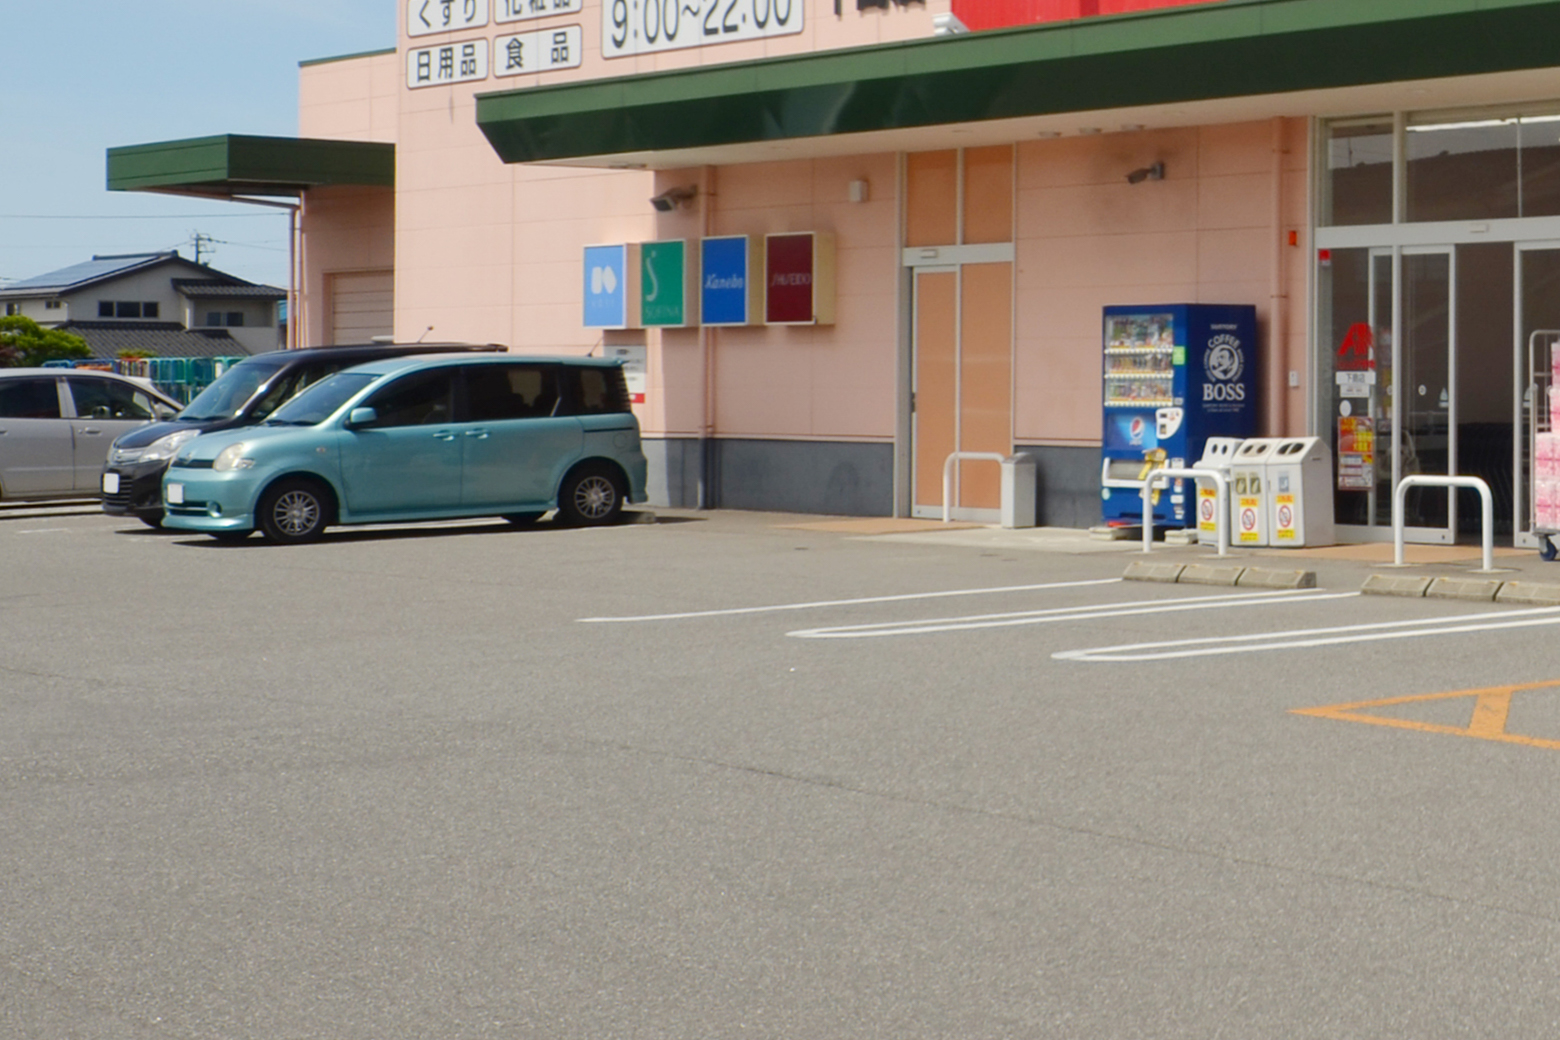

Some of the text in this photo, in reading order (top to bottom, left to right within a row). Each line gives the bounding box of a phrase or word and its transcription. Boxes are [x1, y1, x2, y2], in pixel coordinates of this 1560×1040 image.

[416, 43, 477, 83] 日用品
[705, 273, 744, 289] Kanebo
[1207, 333, 1241, 349] COFFEE
[1202, 383, 1246, 401] BOSS
